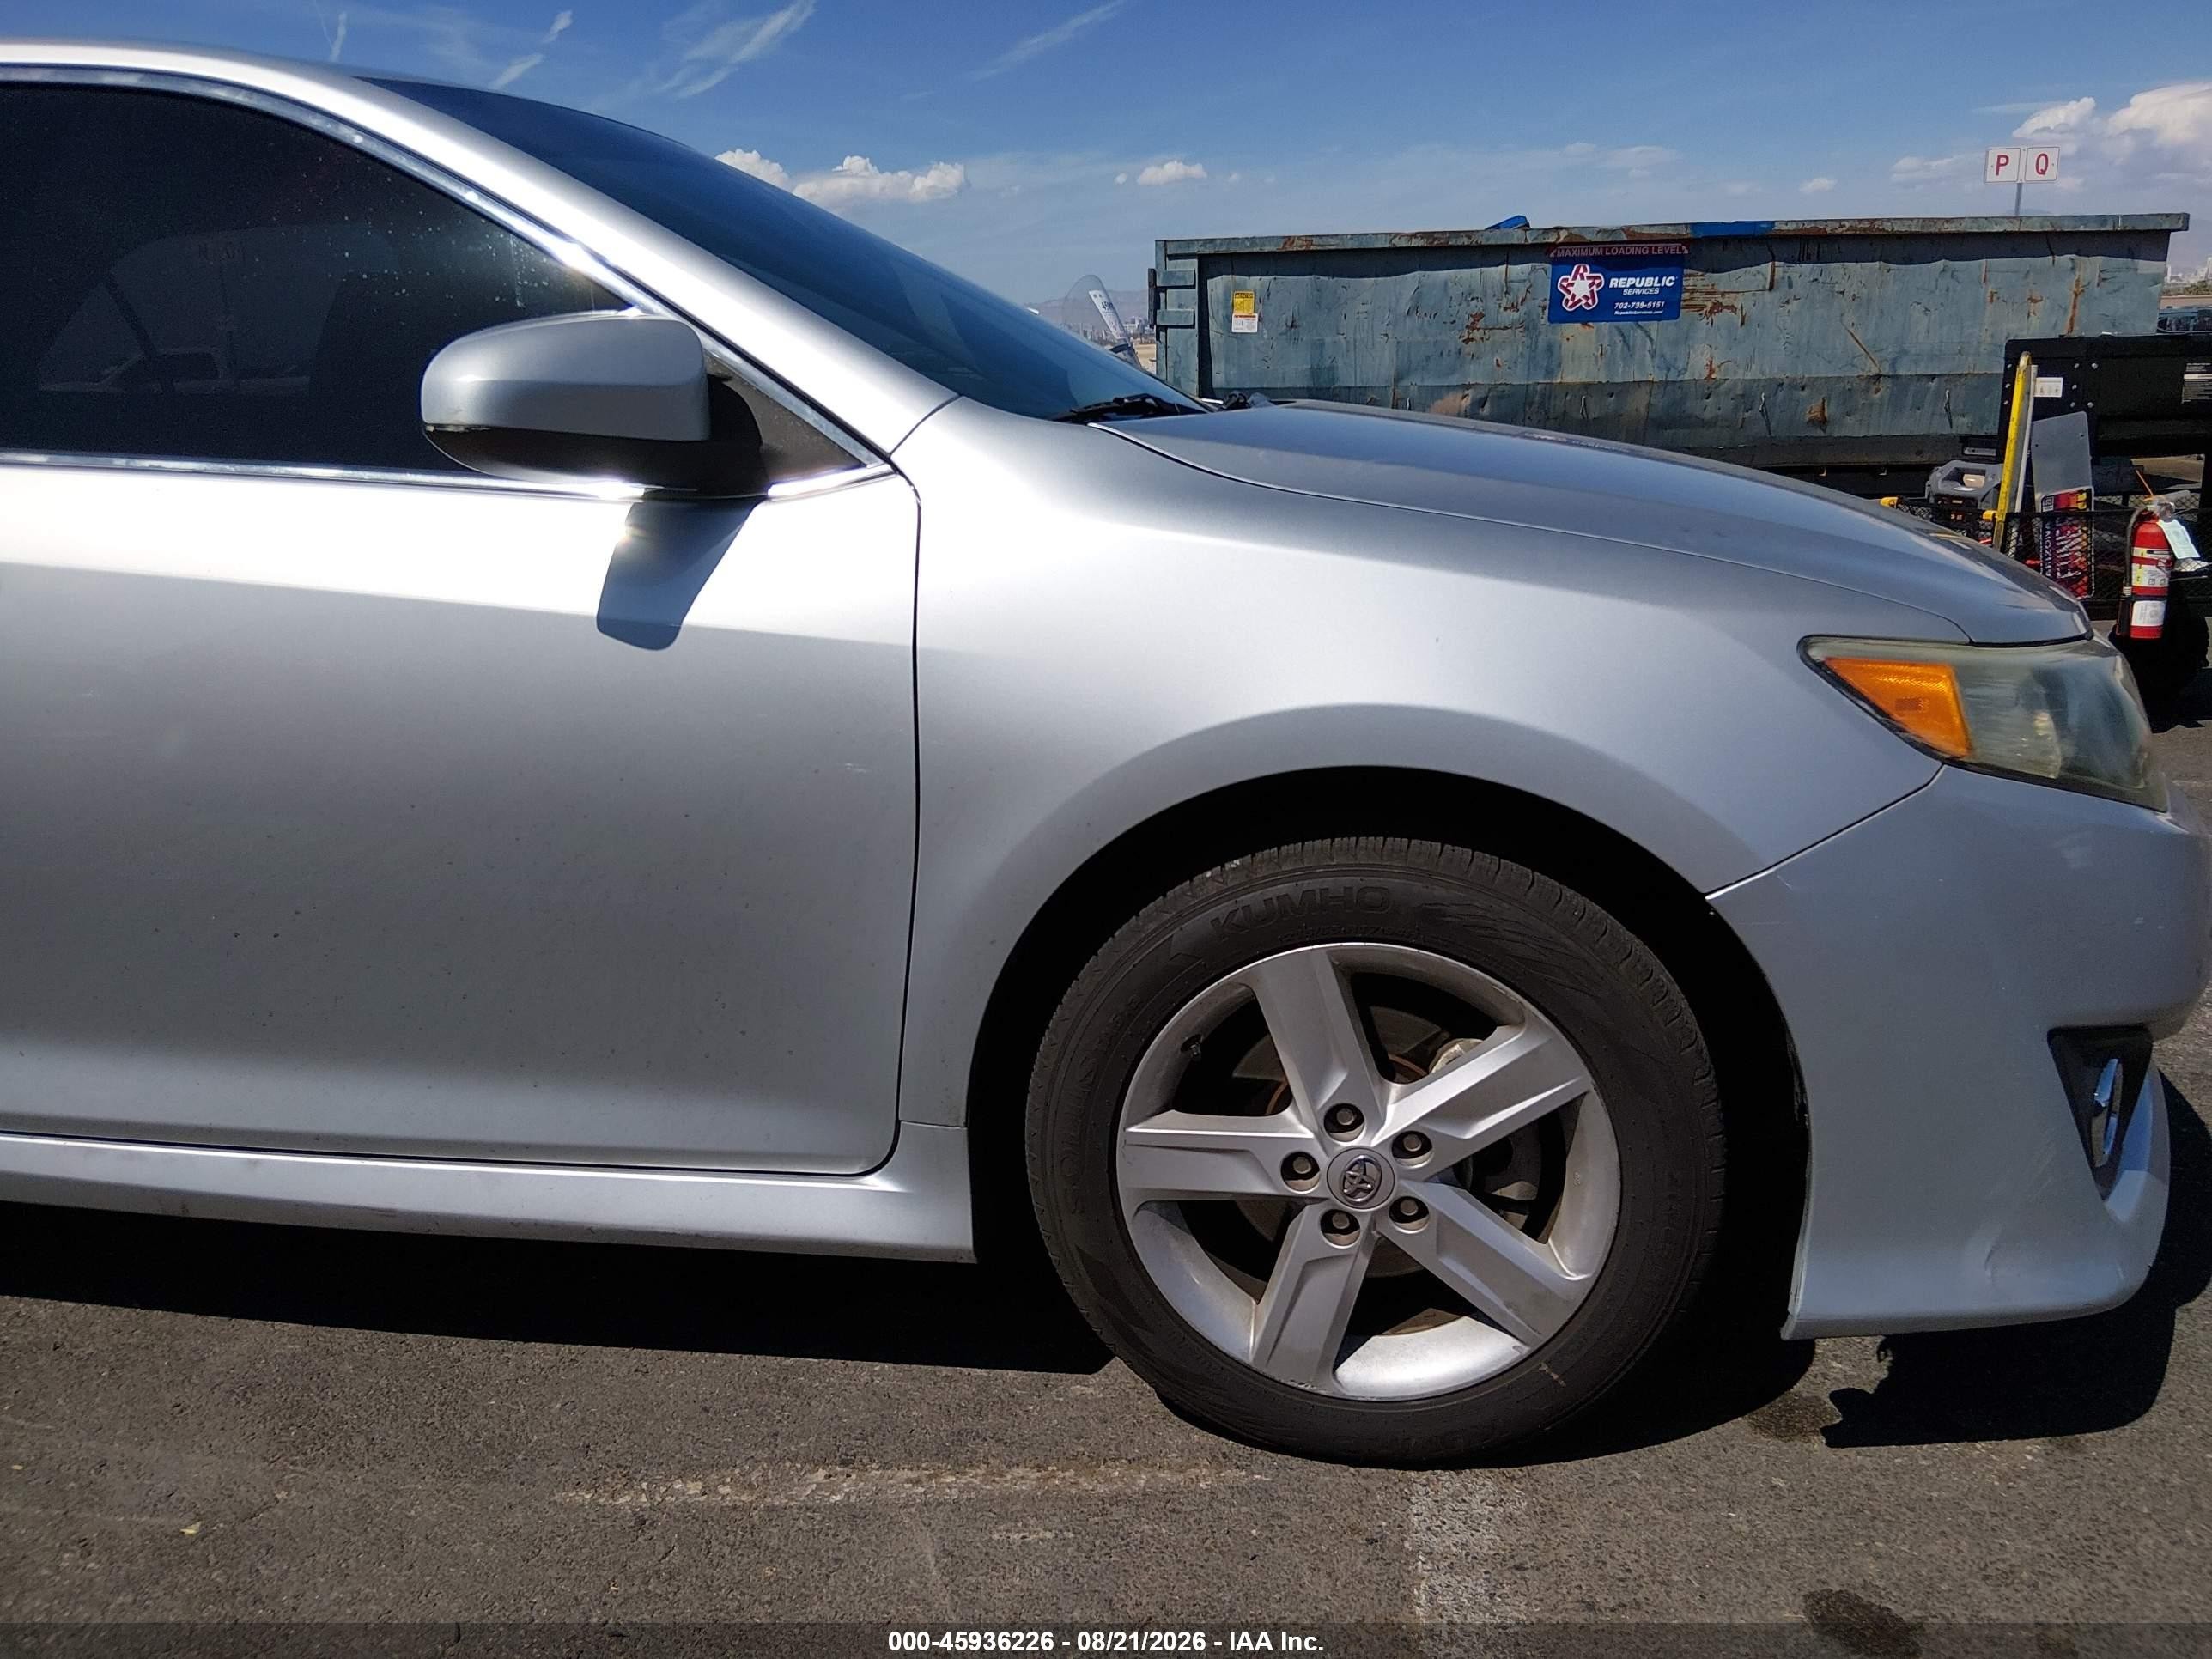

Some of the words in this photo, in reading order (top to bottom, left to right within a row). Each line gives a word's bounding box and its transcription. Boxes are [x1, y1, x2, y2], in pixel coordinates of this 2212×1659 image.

[1995, 154, 2009, 176] P
[2035, 153, 2049, 176] Q
[1556, 246, 1603, 257] MAXIMUM
[1605, 246, 1650, 256] LOADING
[1651, 246, 1682, 255] LEVEL
[1608, 276, 1675, 289] REPUBLIC
[1210, 885, 1393, 934] KUMHO
